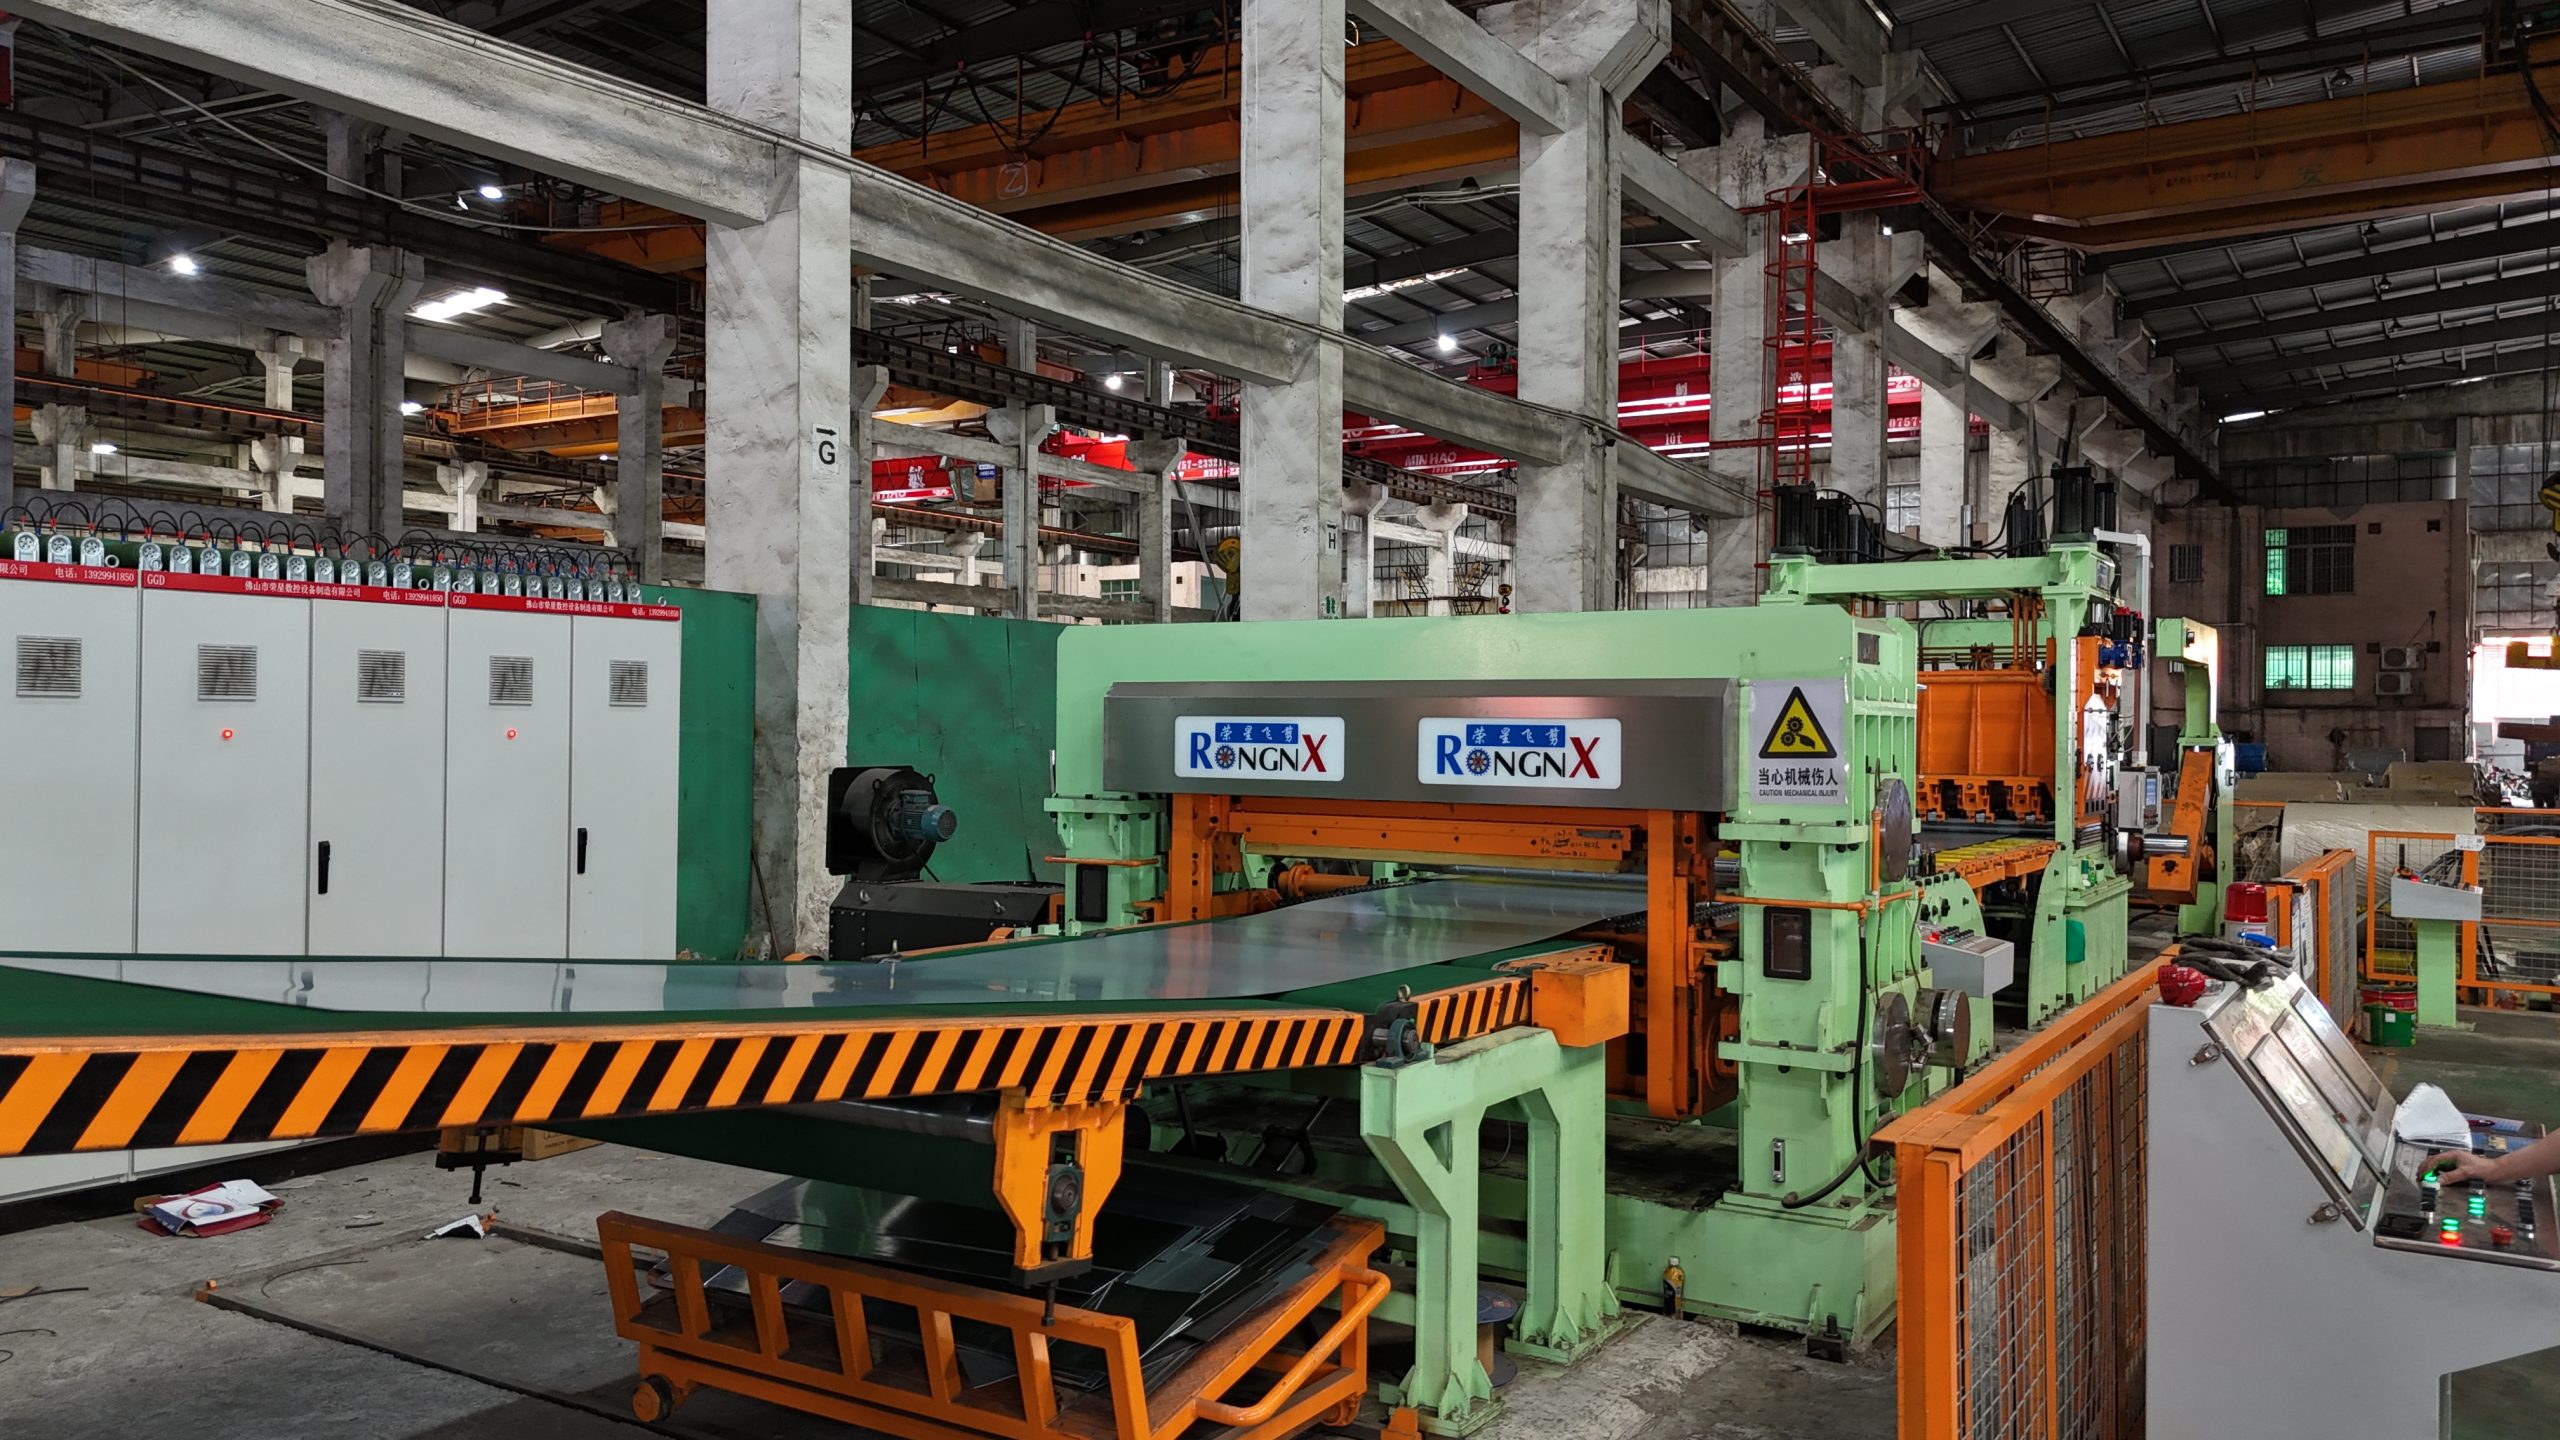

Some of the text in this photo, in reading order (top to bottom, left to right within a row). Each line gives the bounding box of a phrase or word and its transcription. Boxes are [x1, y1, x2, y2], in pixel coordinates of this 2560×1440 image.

[819, 440, 836, 465] G
[1328, 532, 1336, 549] H
[147, 574, 166, 586] GGD
[452, 595, 467, 605] GGD
[1220, 725, 1294, 743] 荣星飞剪
[1472, 727, 1560, 746] 荣星飞剪
[1758, 767, 1838, 786] 当心机械伤人
[1759, 789, 1838, 797] CAUTION MECHANICAL INJURY
